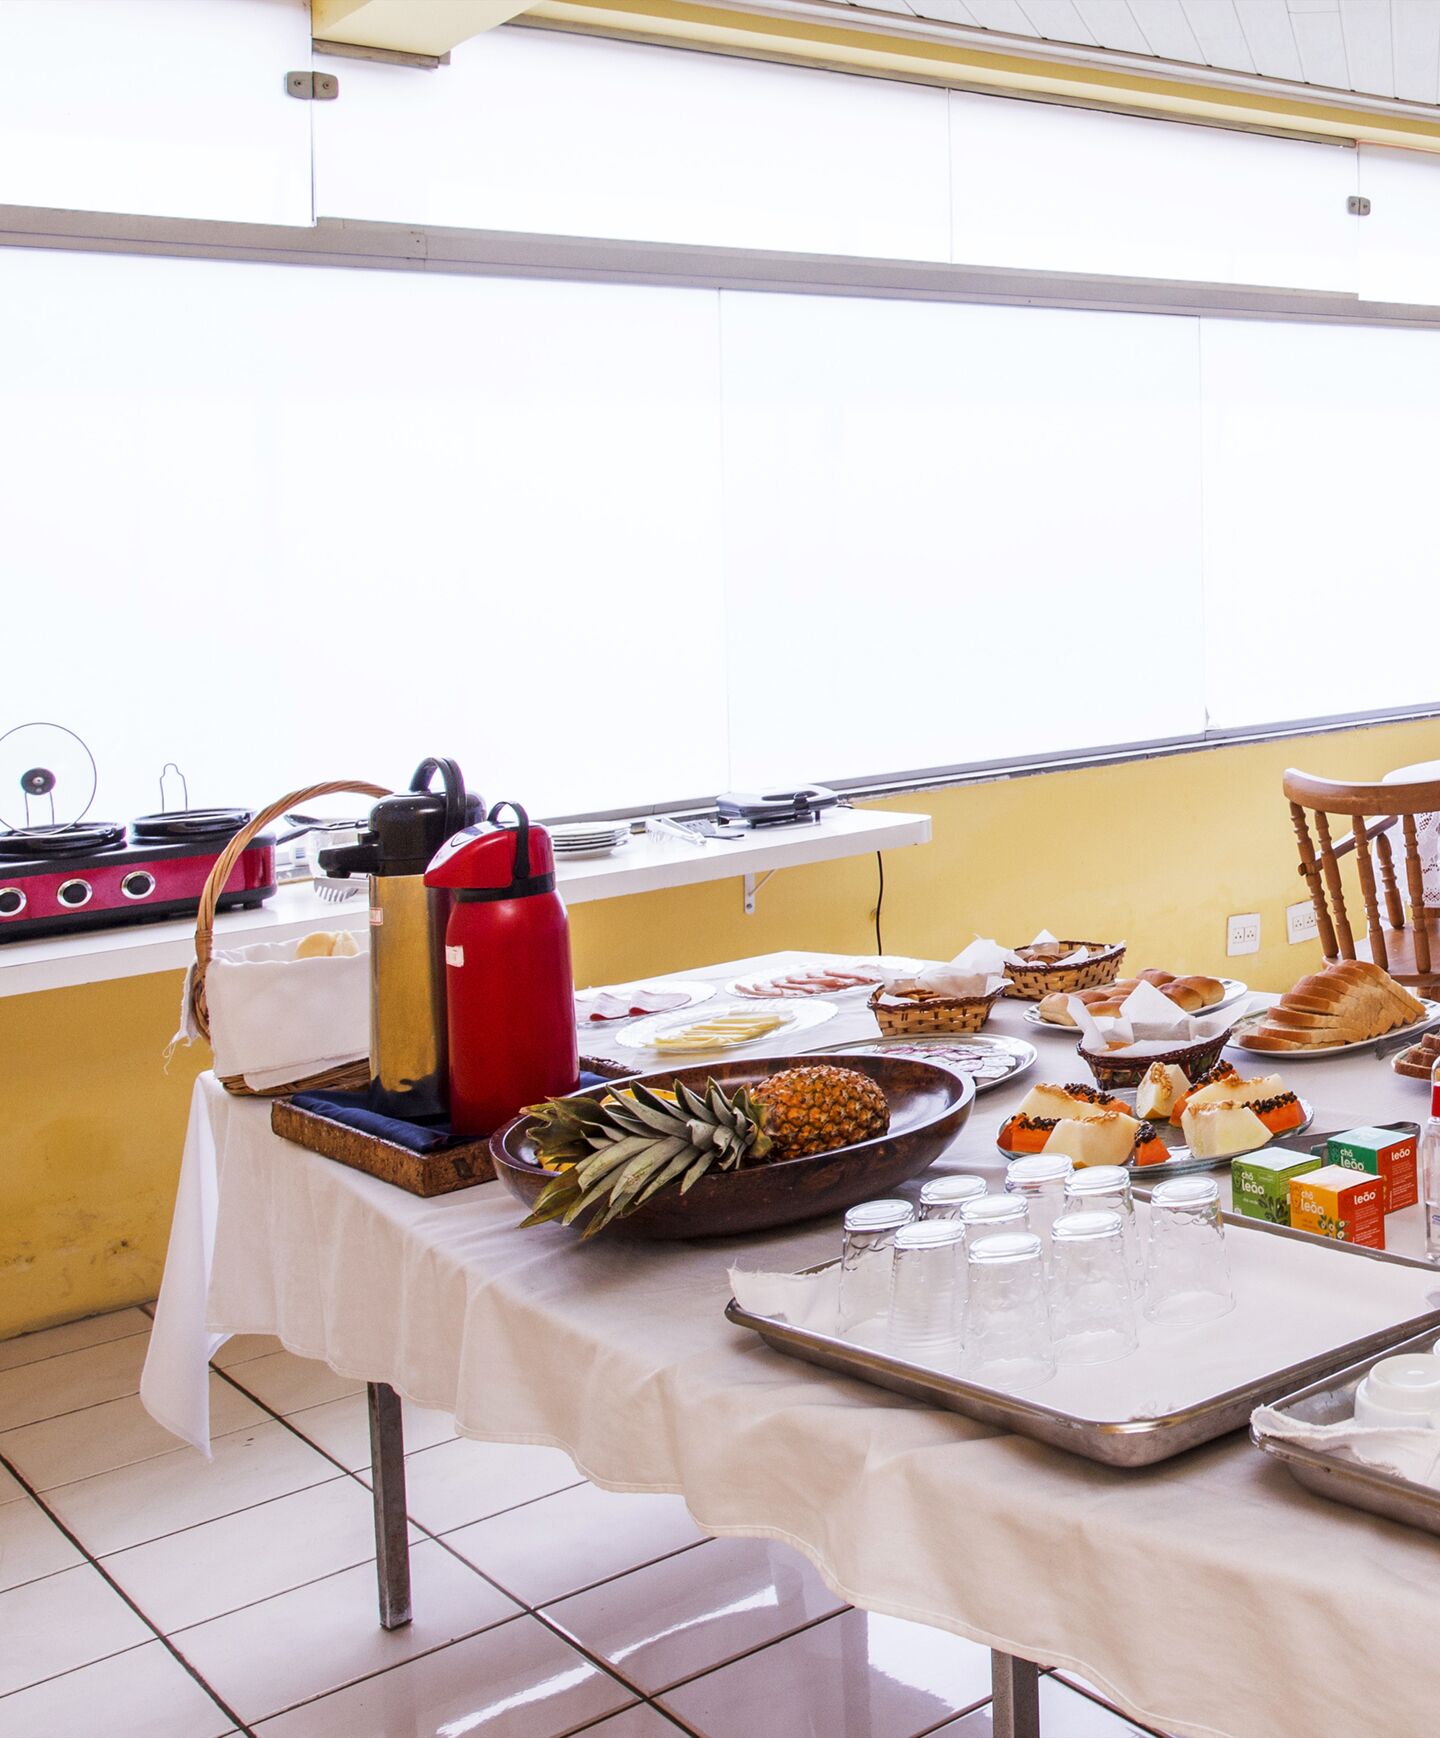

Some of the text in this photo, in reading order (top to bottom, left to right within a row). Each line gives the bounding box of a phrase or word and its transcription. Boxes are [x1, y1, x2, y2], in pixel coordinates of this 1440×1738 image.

[1391, 1148, 1411, 1161] leão
[1241, 1179, 1264, 1195] leão
[1353, 1191, 1376, 1205] leão
[1300, 1198, 1324, 1215] leão
